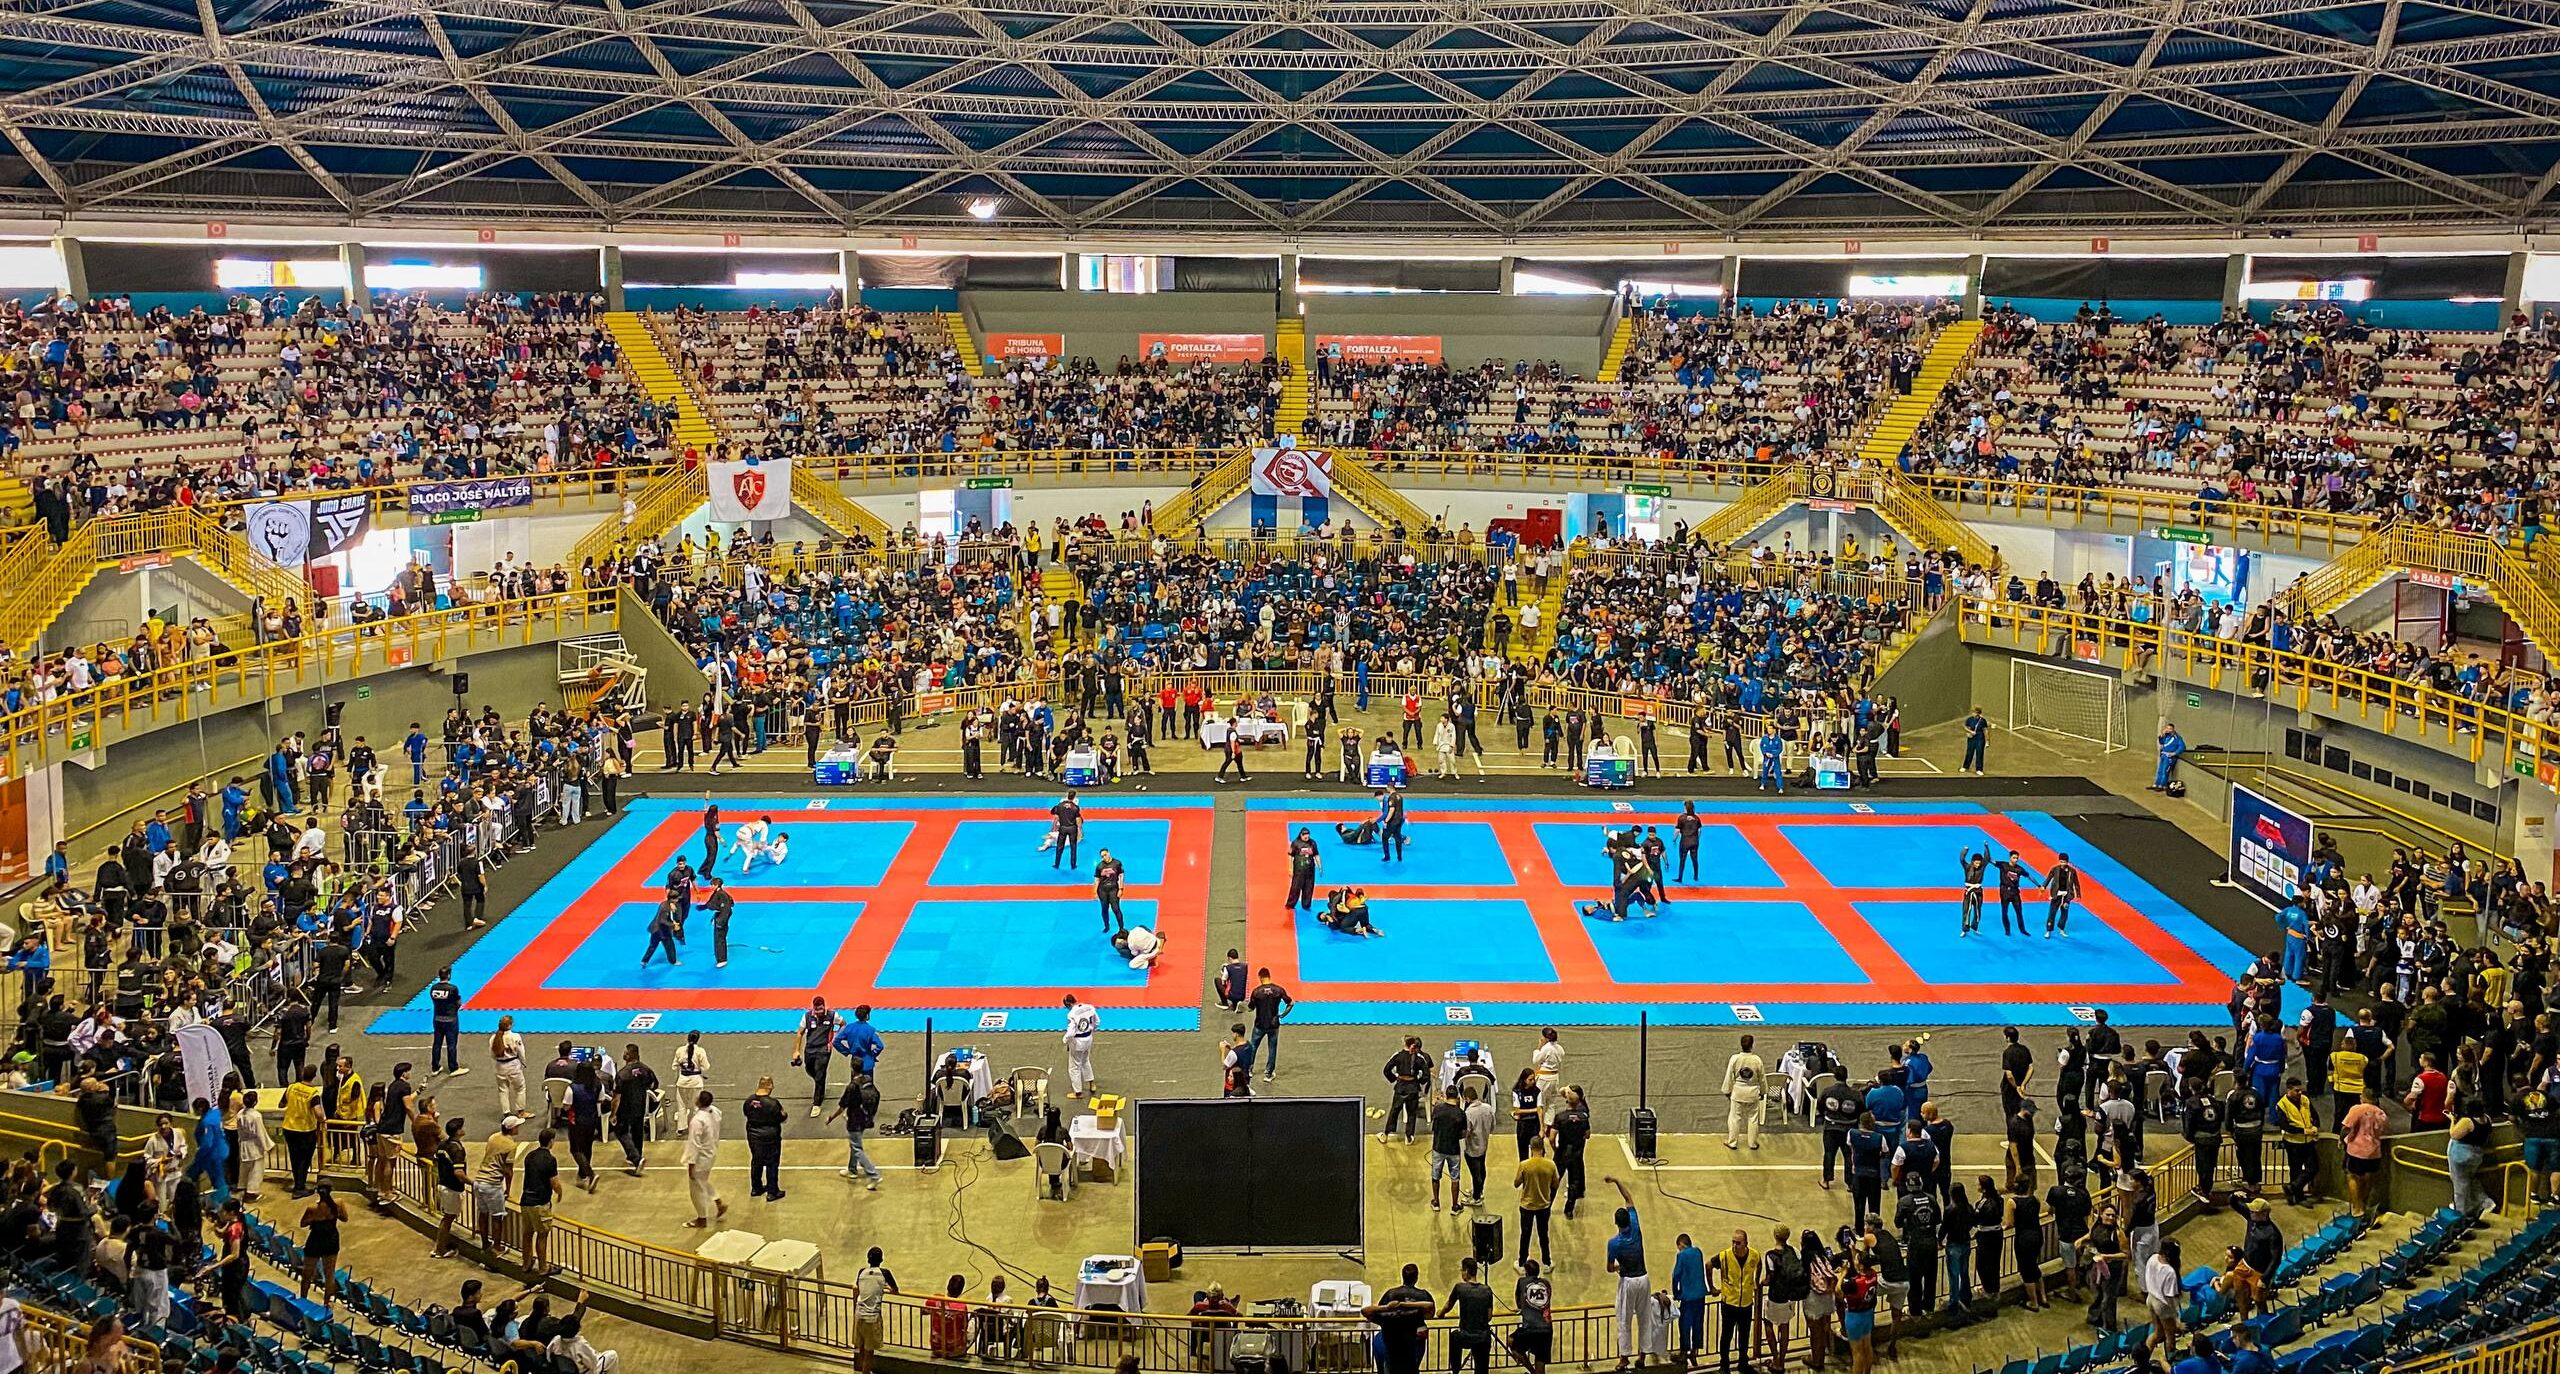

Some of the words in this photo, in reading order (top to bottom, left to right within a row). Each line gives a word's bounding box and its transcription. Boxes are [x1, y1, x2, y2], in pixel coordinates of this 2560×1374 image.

[211, 224, 222, 234] O
[481, 231, 491, 240] O
[728, 235, 737, 244] N
[905, 238, 914, 246] N
[1847, 242, 1858, 252] M
[2097, 240, 2104, 251] L
[2364, 237, 2371, 249] L
[1666, 243, 1677, 252] M
[1006, 339, 1045, 347] TRIBUNA
[1170, 343, 1223, 352] FORTALEZA
[1003, 346, 1016, 354] DE
[1016, 346, 1048, 354] HONRA
[1346, 345, 1398, 354] FORTALEZA
[411, 493, 450, 505] BLOCO
[451, 488, 483, 501] JOSÉ
[484, 486, 531, 499] WALTER
[2421, 574, 2441, 584] BAR
[402, 651, 409, 662] E
[2089, 647, 2097, 658] A
[944, 696, 952, 706] D
[1646, 704, 1654, 714] B
